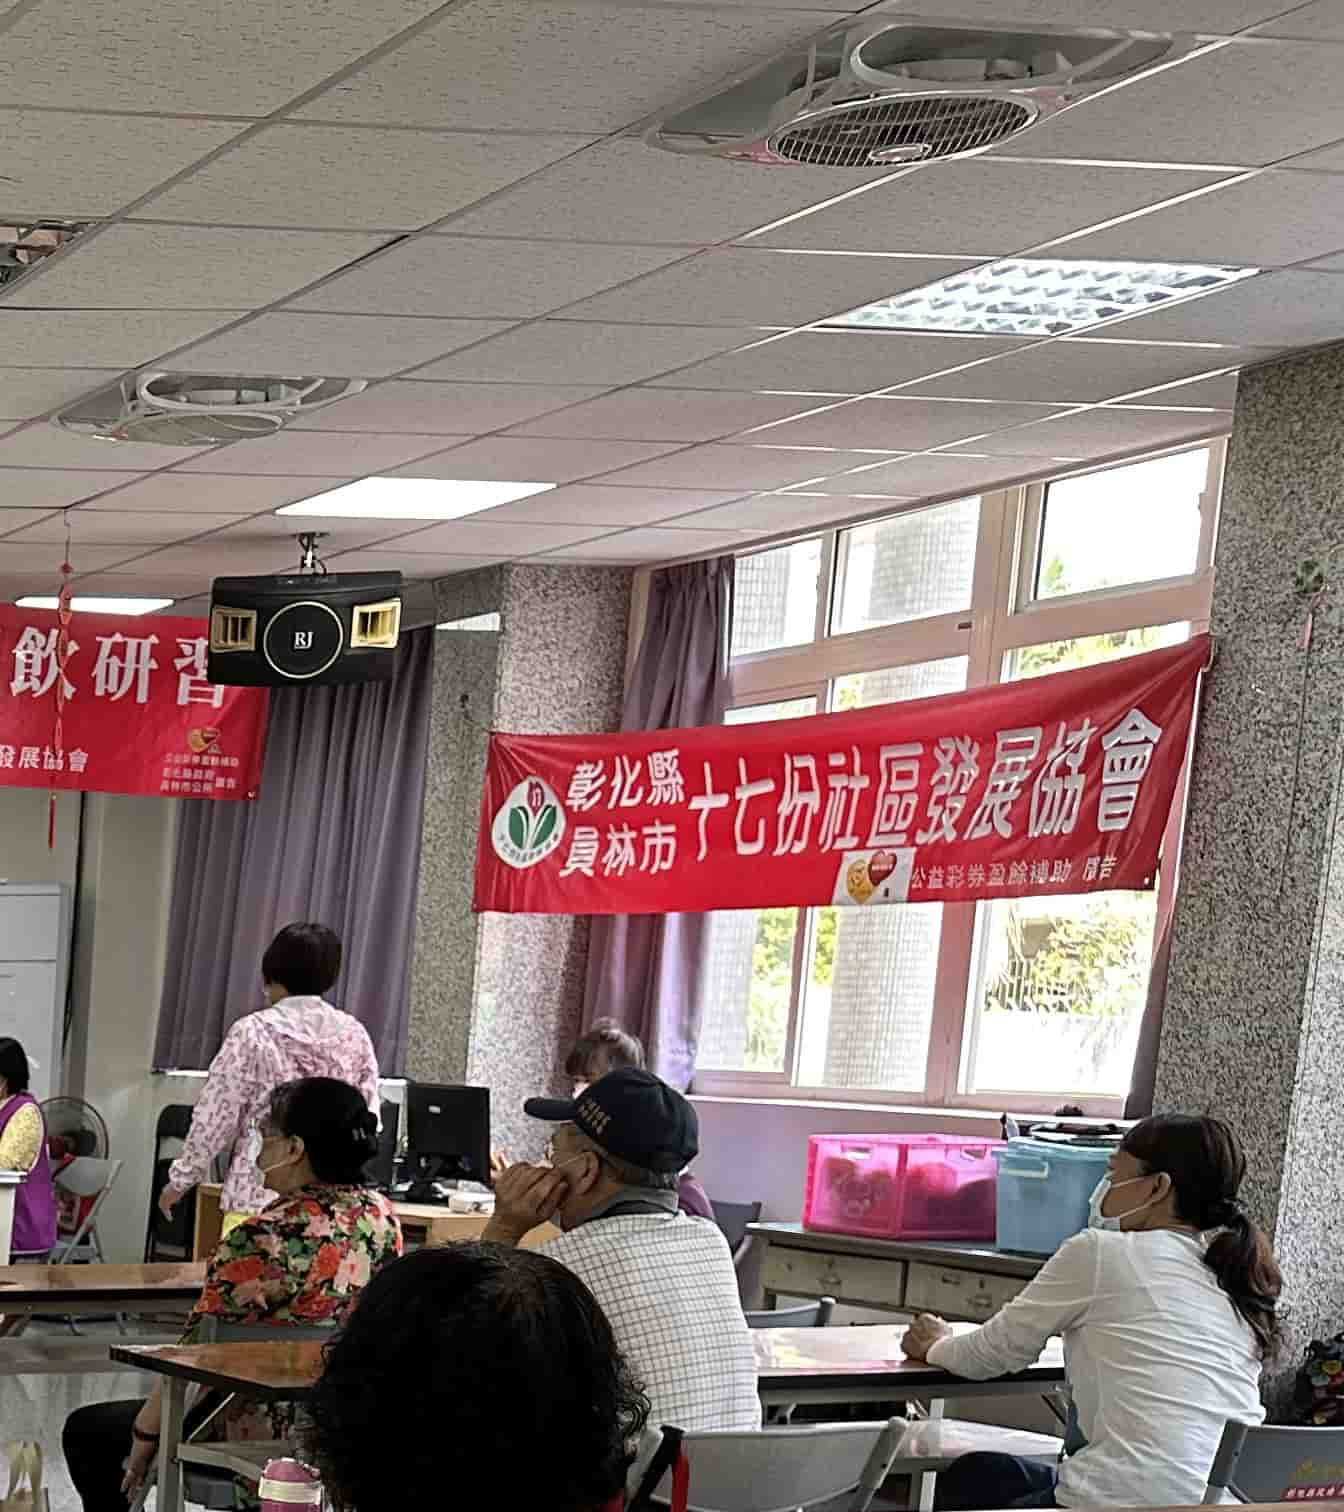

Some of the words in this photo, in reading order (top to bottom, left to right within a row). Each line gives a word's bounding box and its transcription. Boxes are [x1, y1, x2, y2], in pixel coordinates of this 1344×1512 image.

[293, 631, 314, 649] RJ
[565, 748, 685, 812] 彰化縣
[688, 708, 1163, 860] 十七份社區發展協會
[559, 819, 677, 877] 員林市
